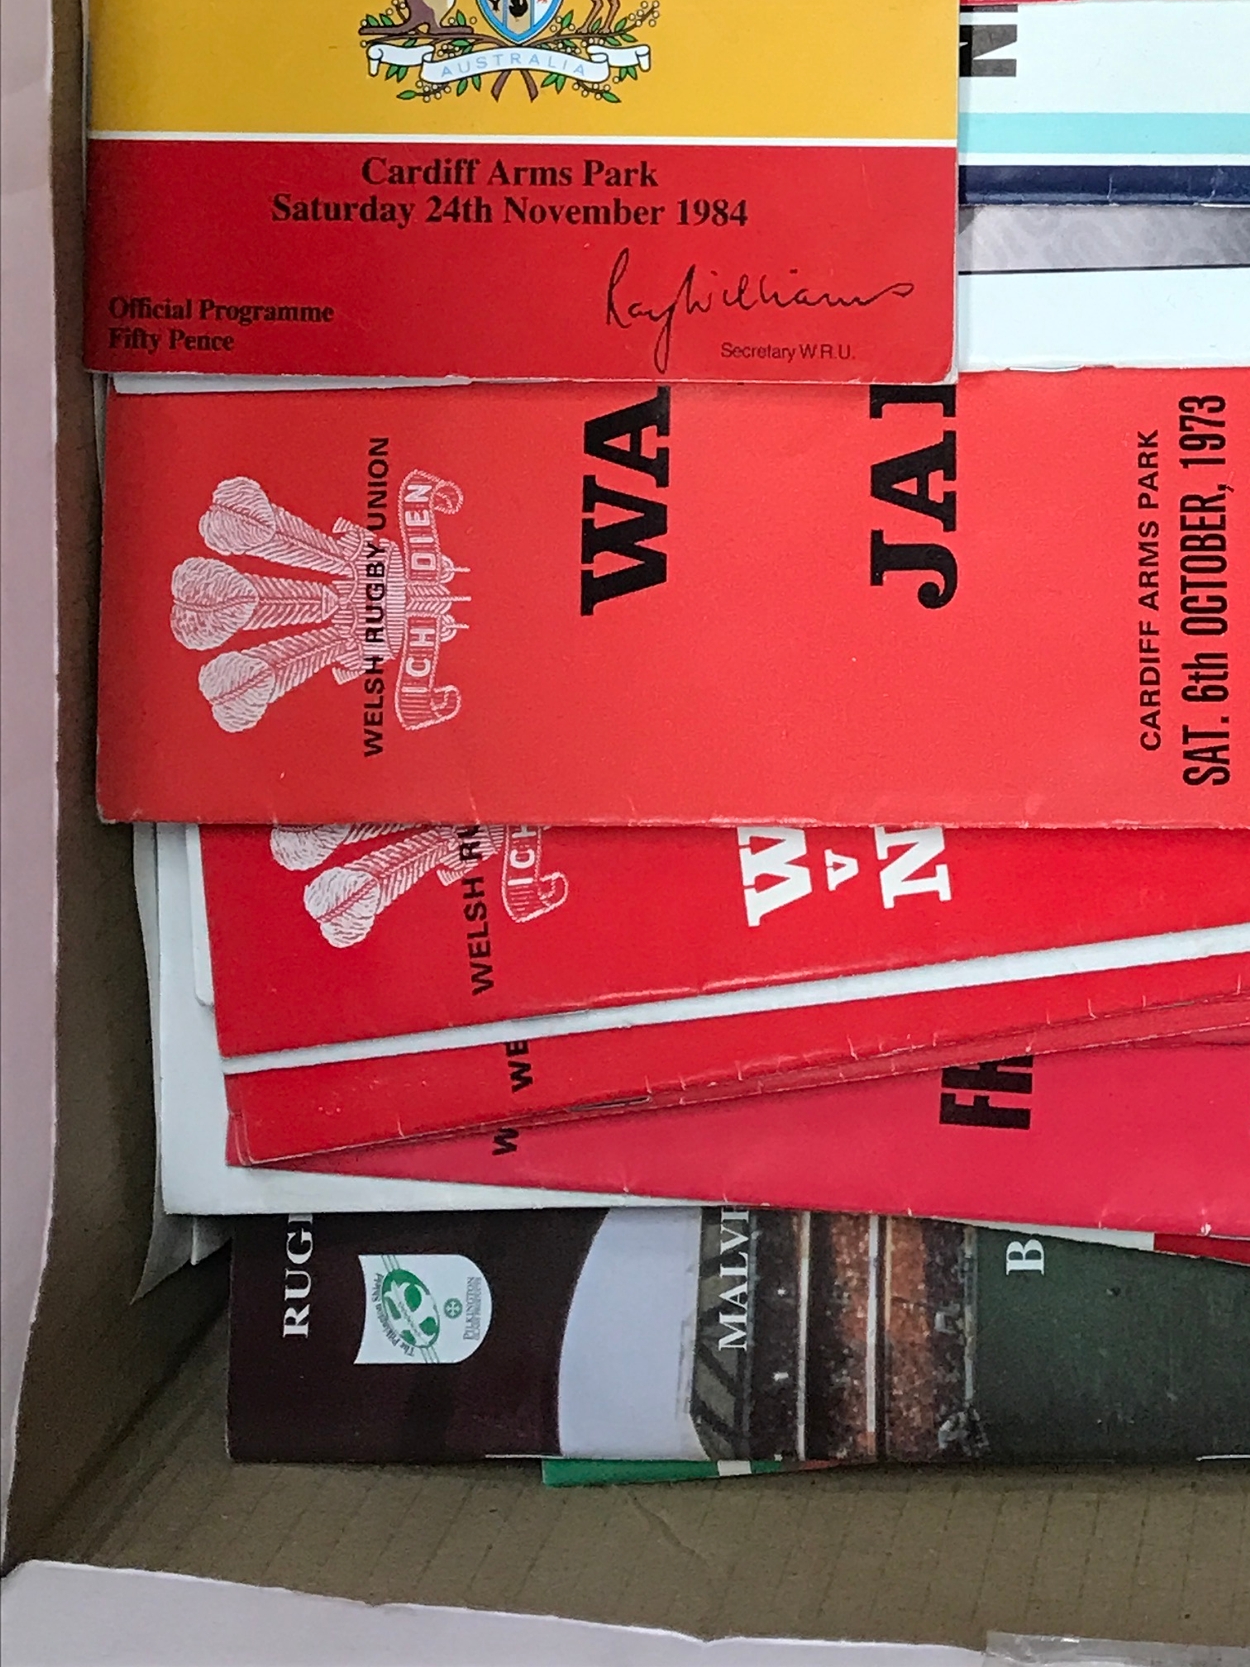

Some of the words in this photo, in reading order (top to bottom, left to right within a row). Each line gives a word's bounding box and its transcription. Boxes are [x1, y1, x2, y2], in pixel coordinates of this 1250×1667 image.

[439, 48, 588, 80] AUSTRALIA
[361, 157, 480, 189] Cardiff
[487, 159, 575, 189] Arms
[582, 160, 659, 188] Park
[271, 193, 415, 227] Saturday
[425, 195, 494, 226] 24th
[503, 196, 666, 227] November
[676, 199, 749, 228] 1984
[108, 298, 194, 323] Official
[198, 299, 334, 328] Programme
[108, 327, 163, 354] Fifty
[168, 329, 235, 352] Pence
[720, 341, 797, 363] Secretary
[799, 343, 857, 361] W.R.U.
[1136, 429, 1160, 508] PARK
[1178, 395, 1228, 470] 1973
[368, 436, 390, 532] UNION
[408, 480, 440, 573] DIEN
[1179, 483, 1234, 636] OCTOBER,
[363, 540, 387, 648] RUGBY
[1137, 519, 1160, 612] ARMS
[405, 625, 434, 698] ICH
[1138, 621, 1161, 751] CARDIFF
[1181, 652, 1229, 703] 6th
[363, 654, 385, 758] WELSH
[1182, 714, 1230, 786] SAT.
[463, 877, 495, 996] WELSH
[462, 1276, 476, 1340] PILKINGTON
